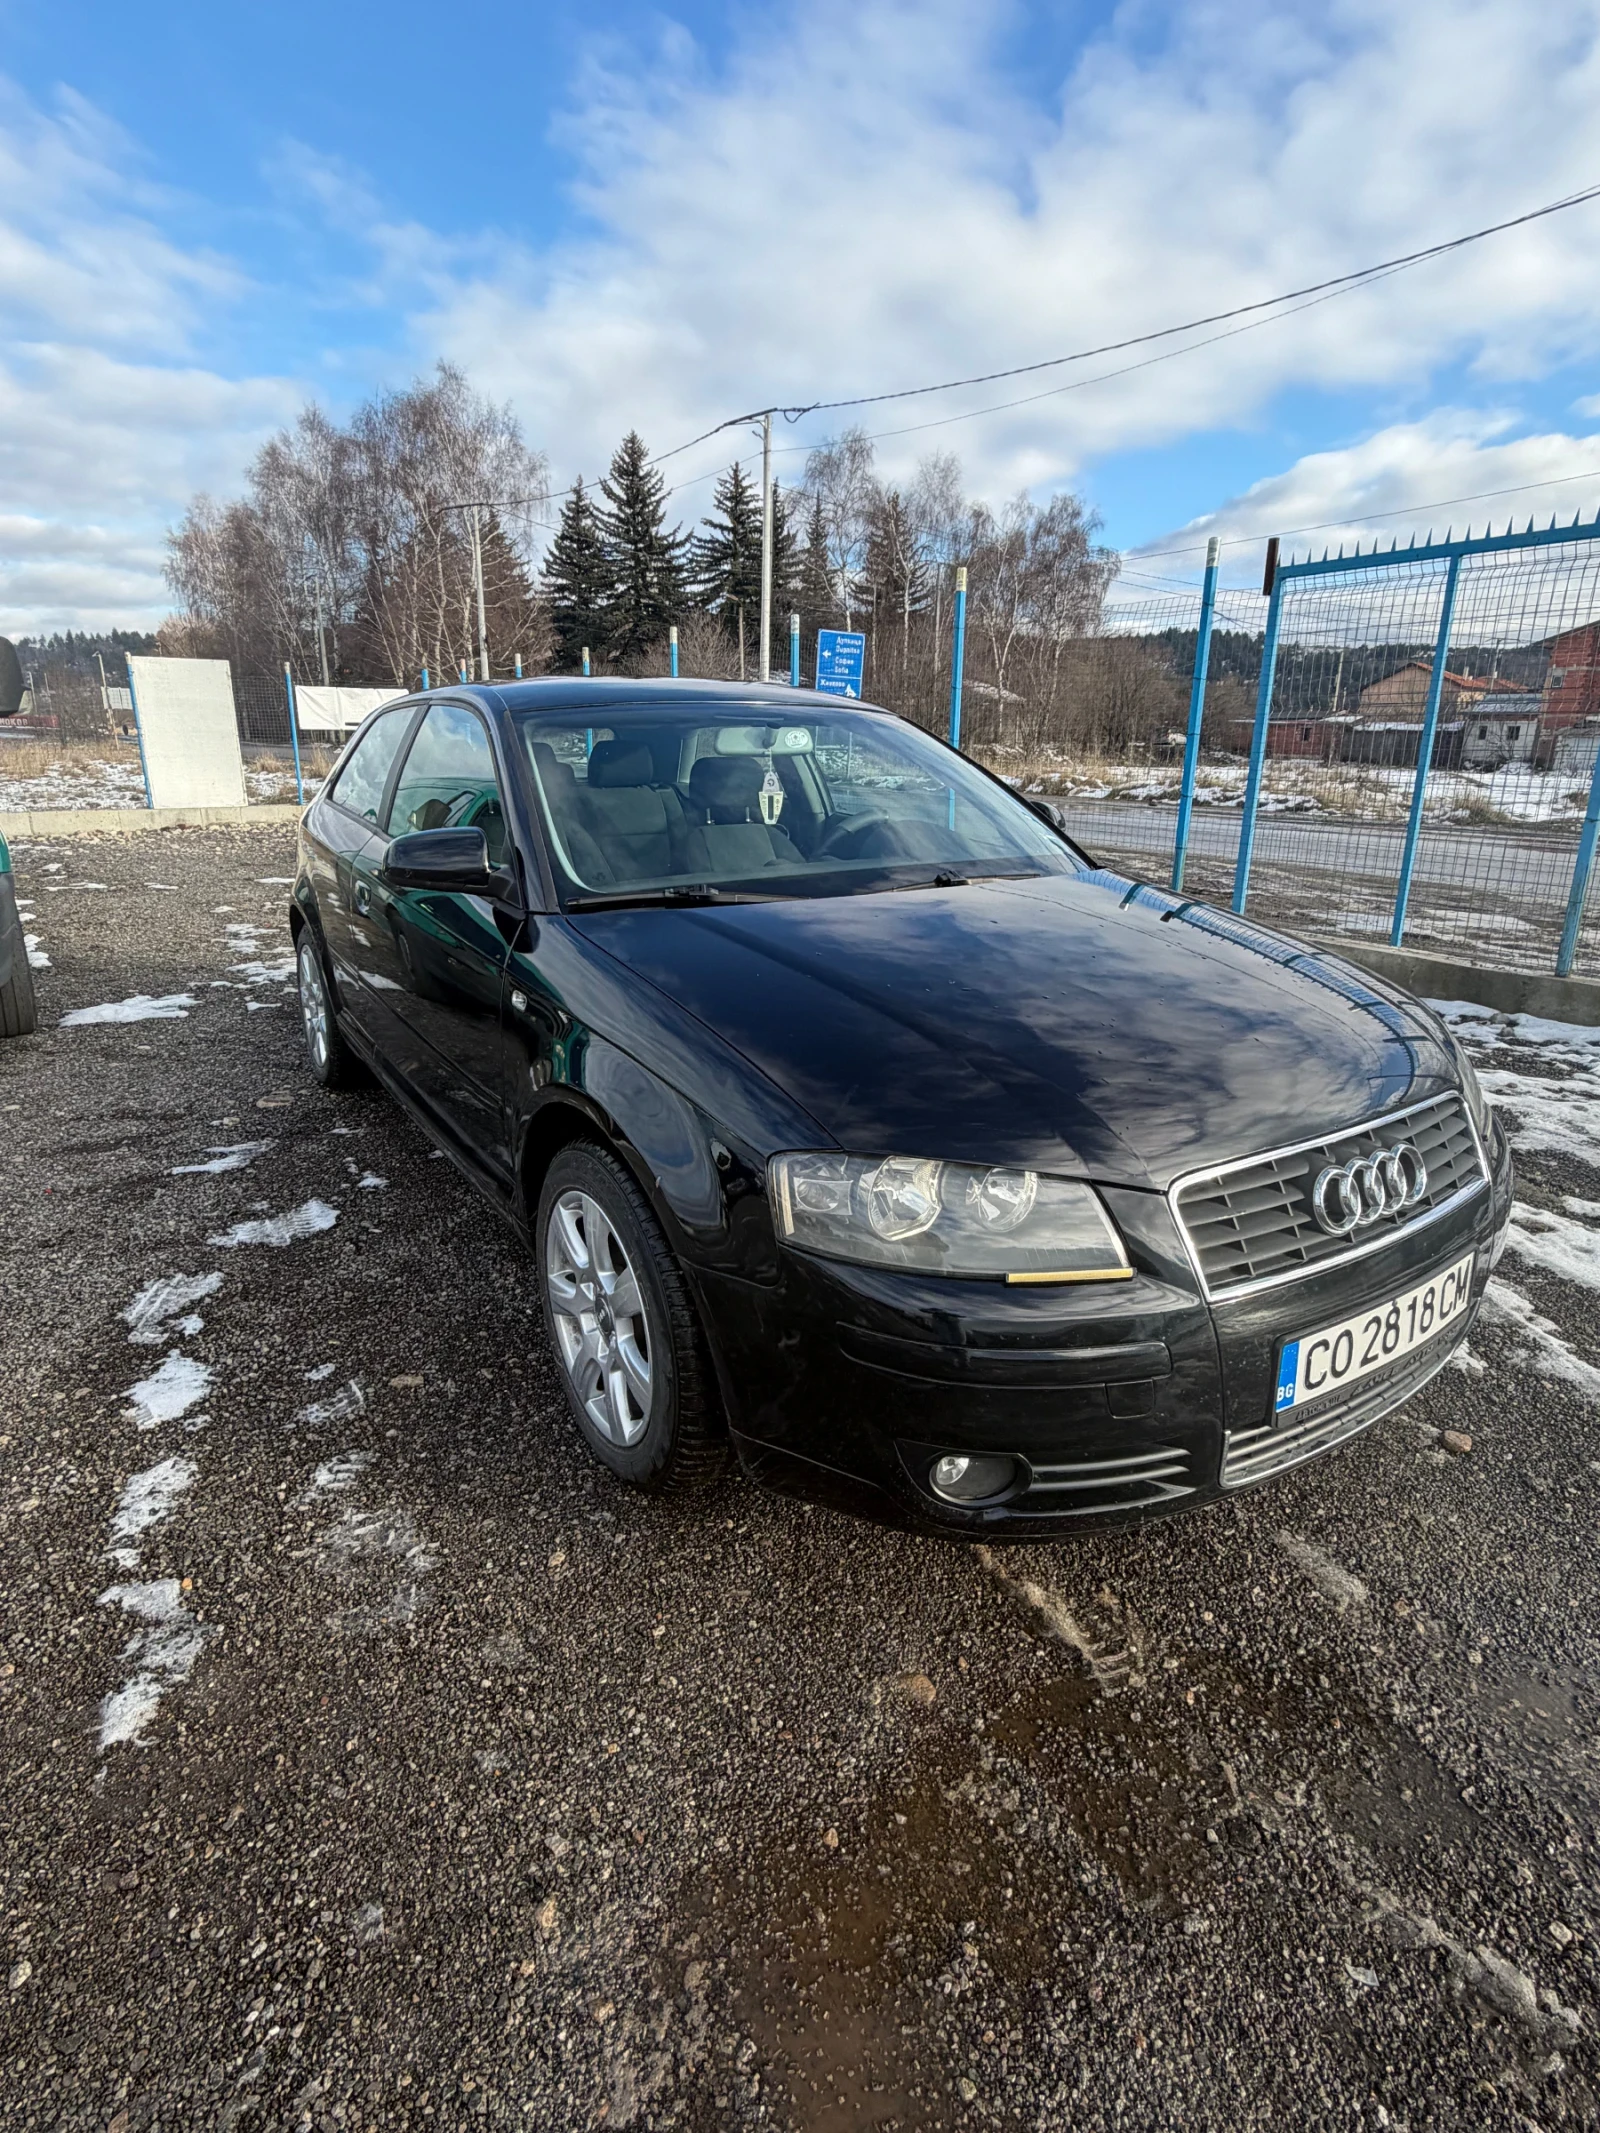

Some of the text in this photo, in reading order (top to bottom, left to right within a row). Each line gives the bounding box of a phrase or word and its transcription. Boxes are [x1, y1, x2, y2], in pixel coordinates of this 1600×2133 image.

[835, 656, 854, 665] София
[834, 666, 849, 674] Sofia
[1276, 1382, 1294, 1402] BG
